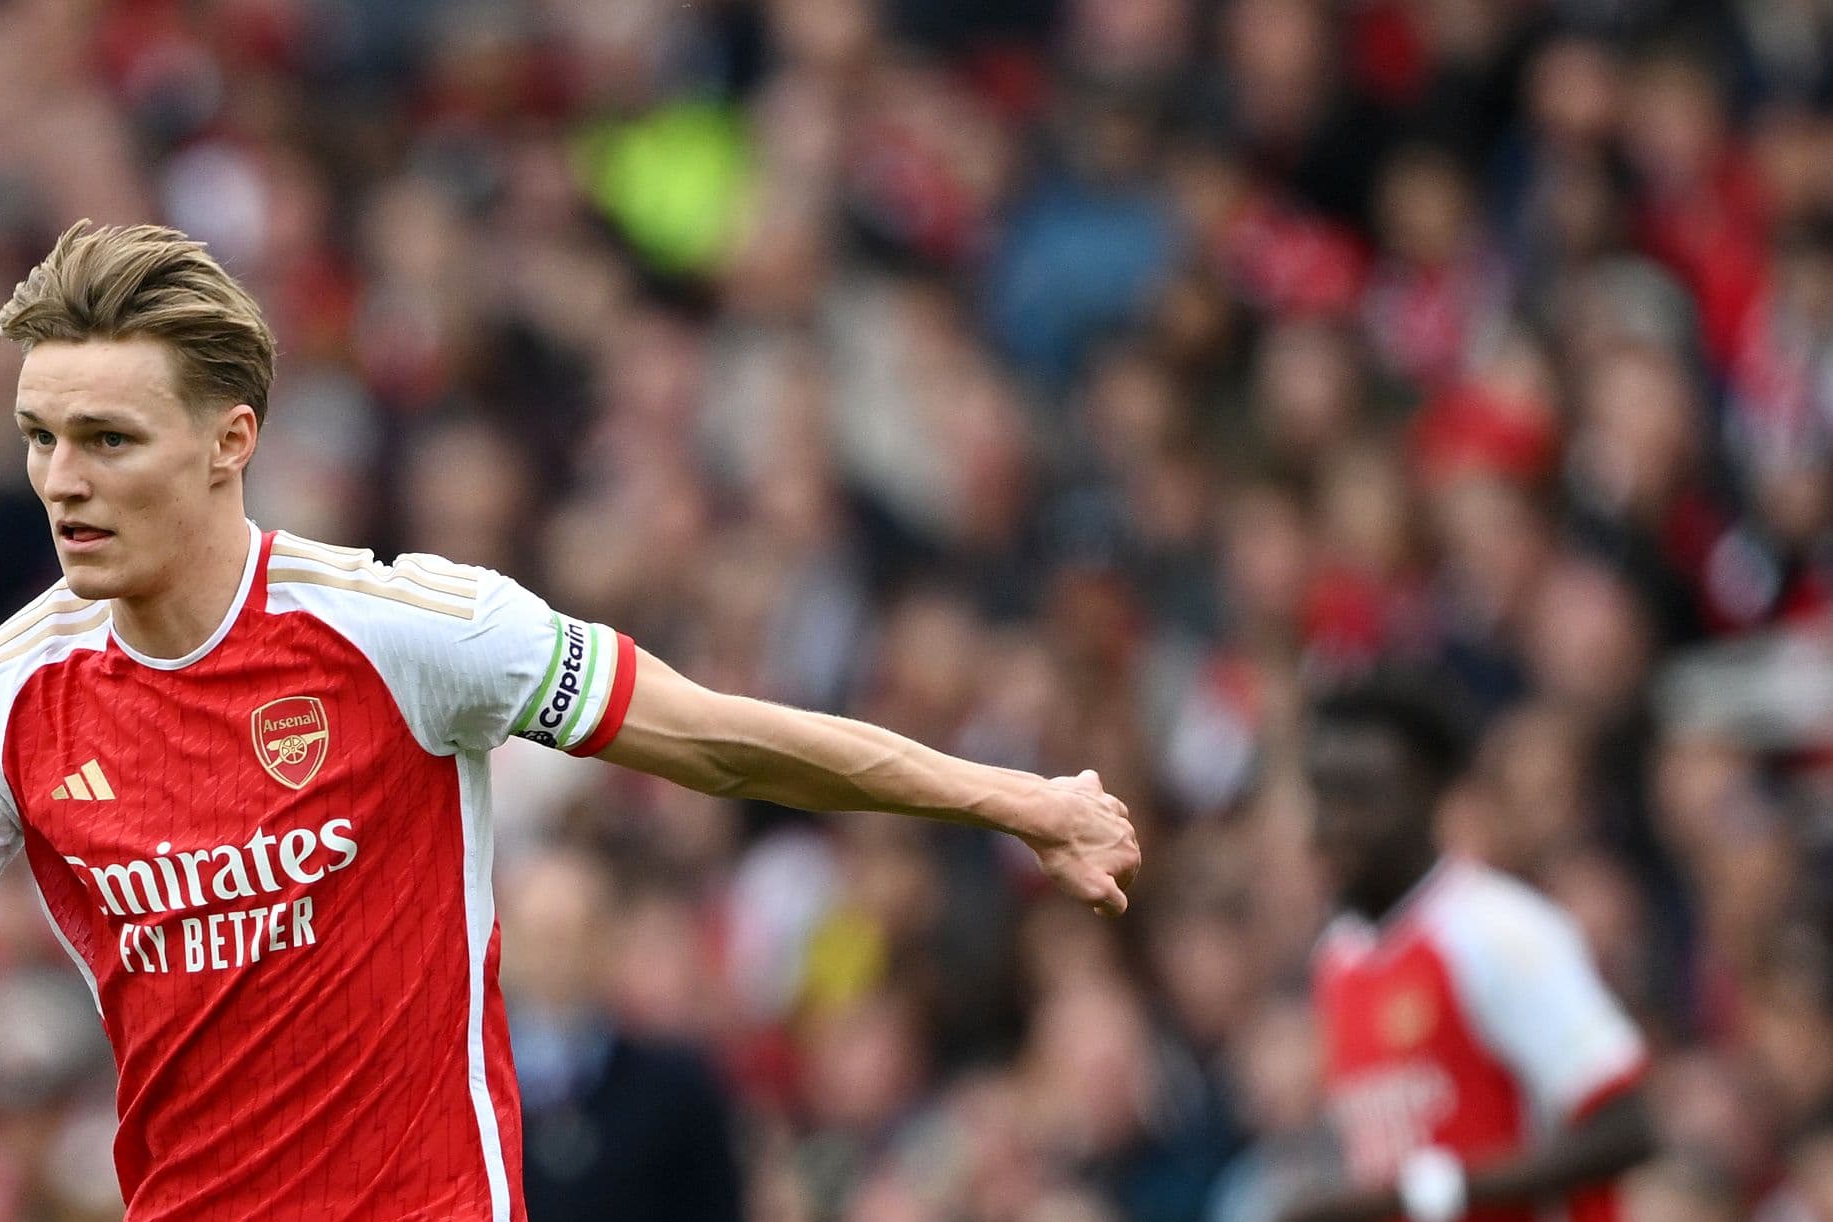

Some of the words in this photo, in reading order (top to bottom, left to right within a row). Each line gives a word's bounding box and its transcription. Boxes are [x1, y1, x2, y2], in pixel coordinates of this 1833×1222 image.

[539, 624, 584, 728] Captain
[262, 710, 316, 733] Arsenal
[119, 923, 169, 974] FLY
[181, 896, 317, 974] BETTER
